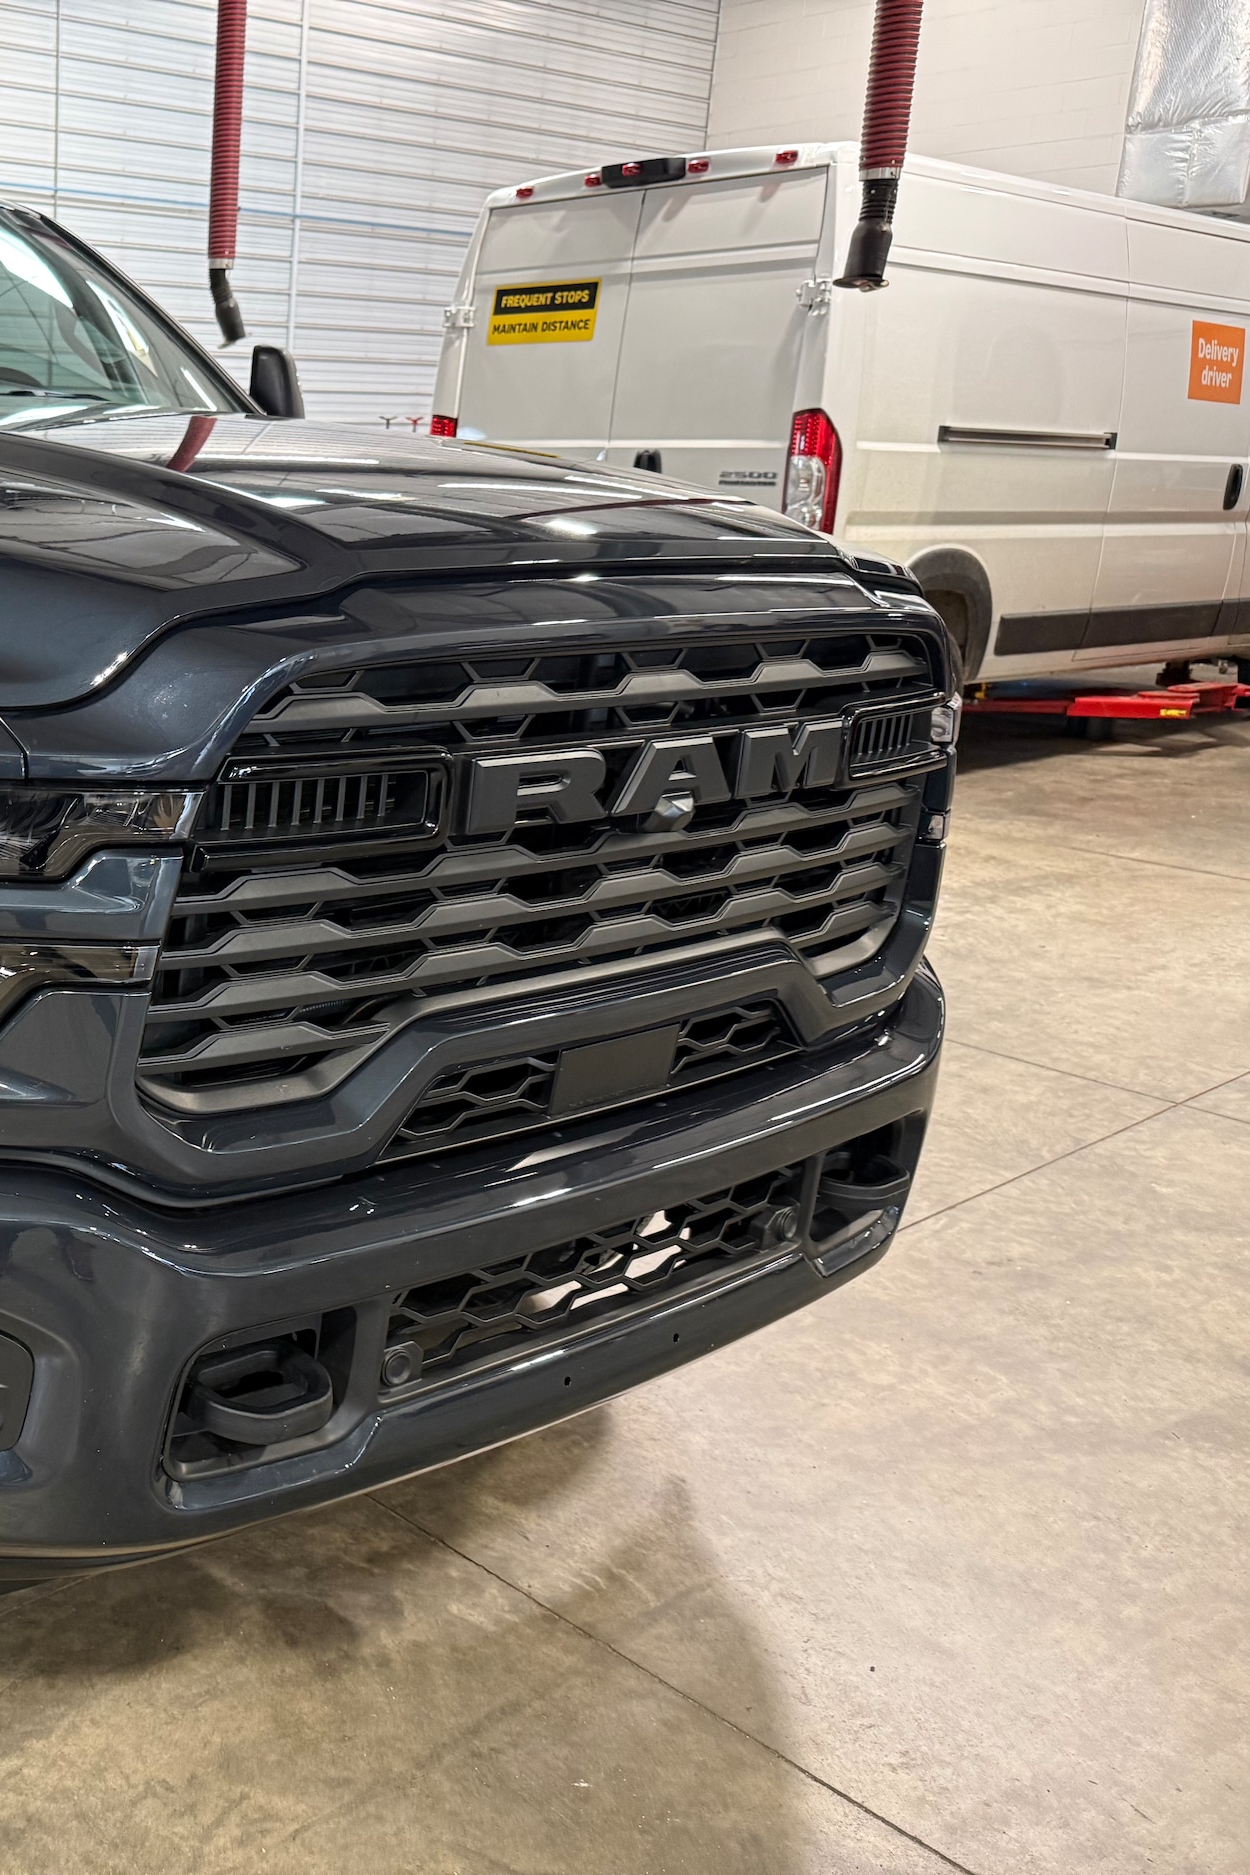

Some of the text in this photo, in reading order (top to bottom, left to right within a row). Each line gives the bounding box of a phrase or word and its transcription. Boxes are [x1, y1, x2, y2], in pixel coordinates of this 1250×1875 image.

[501, 290, 590, 308] FREQUENT STOPS
[492, 319, 591, 335] MAINTAIN DISTANCE
[1198, 337, 1239, 367] Delivery
[1201, 365, 1232, 388] driver
[466, 716, 843, 834] RAM
